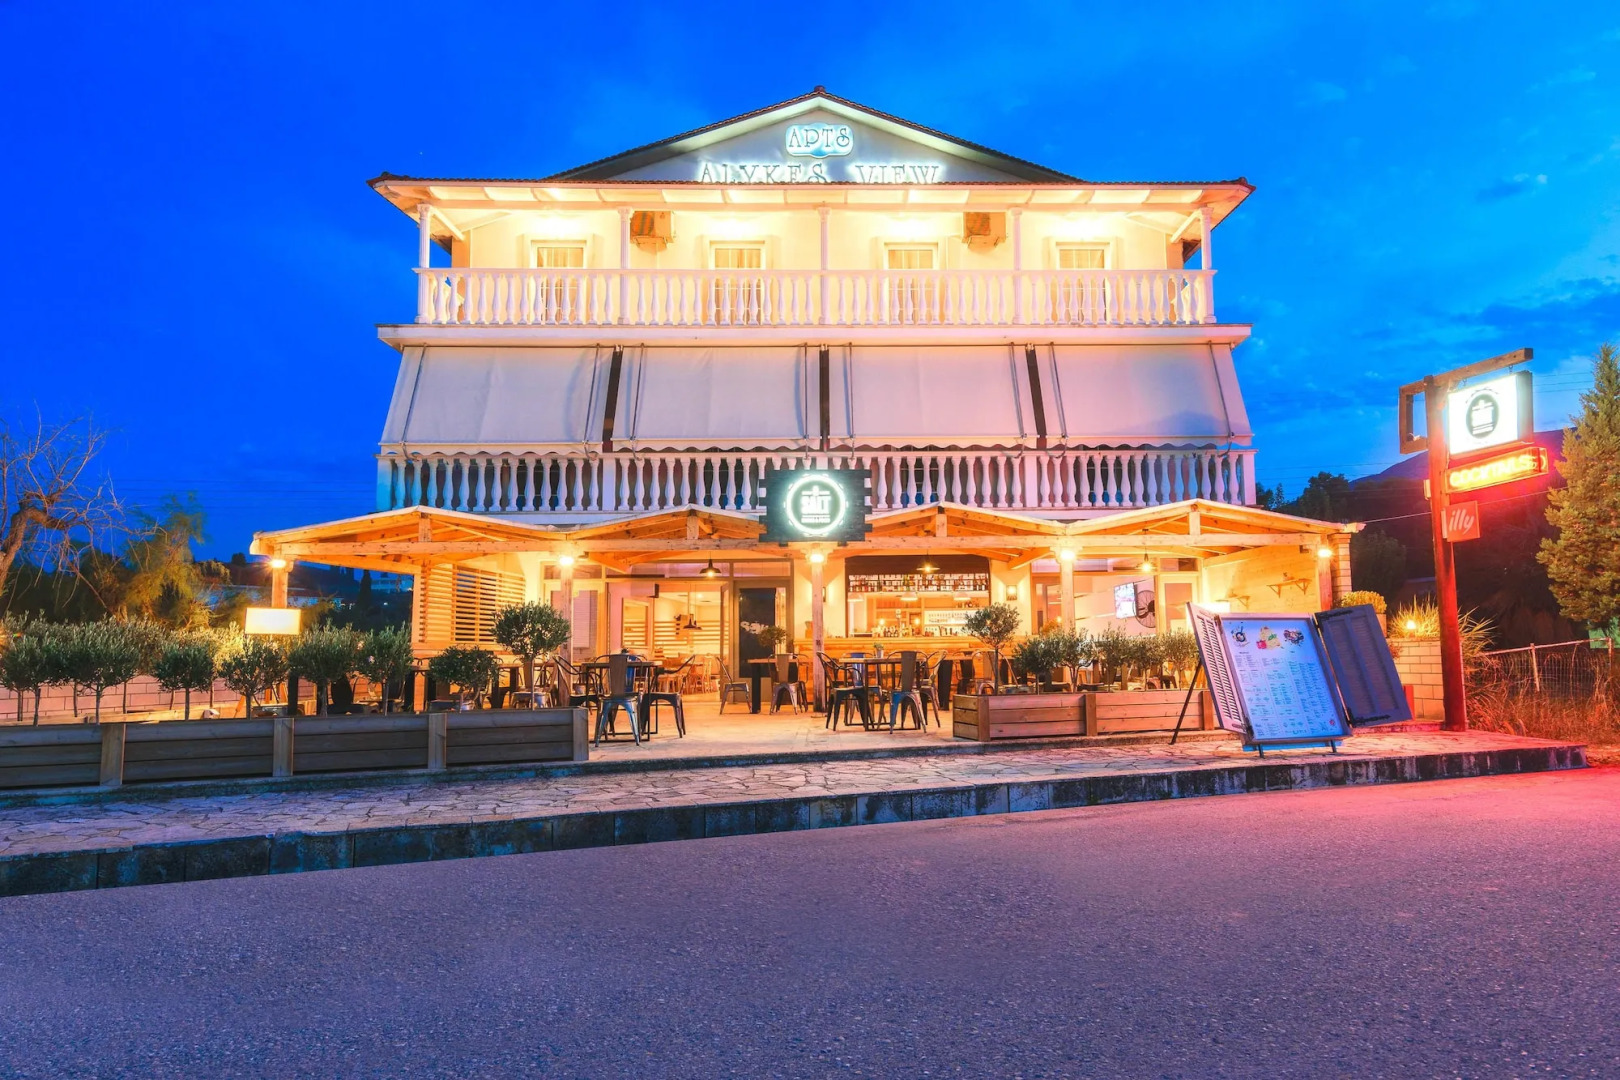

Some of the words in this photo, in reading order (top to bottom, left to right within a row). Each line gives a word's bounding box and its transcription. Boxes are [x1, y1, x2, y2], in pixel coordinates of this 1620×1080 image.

[788, 127, 850, 148] APTS
[700, 163, 828, 184] ALYKES
[855, 164, 940, 184] VIEW
[1449, 454, 1534, 488] COCKTAILS
[1449, 508, 1475, 535] illy
